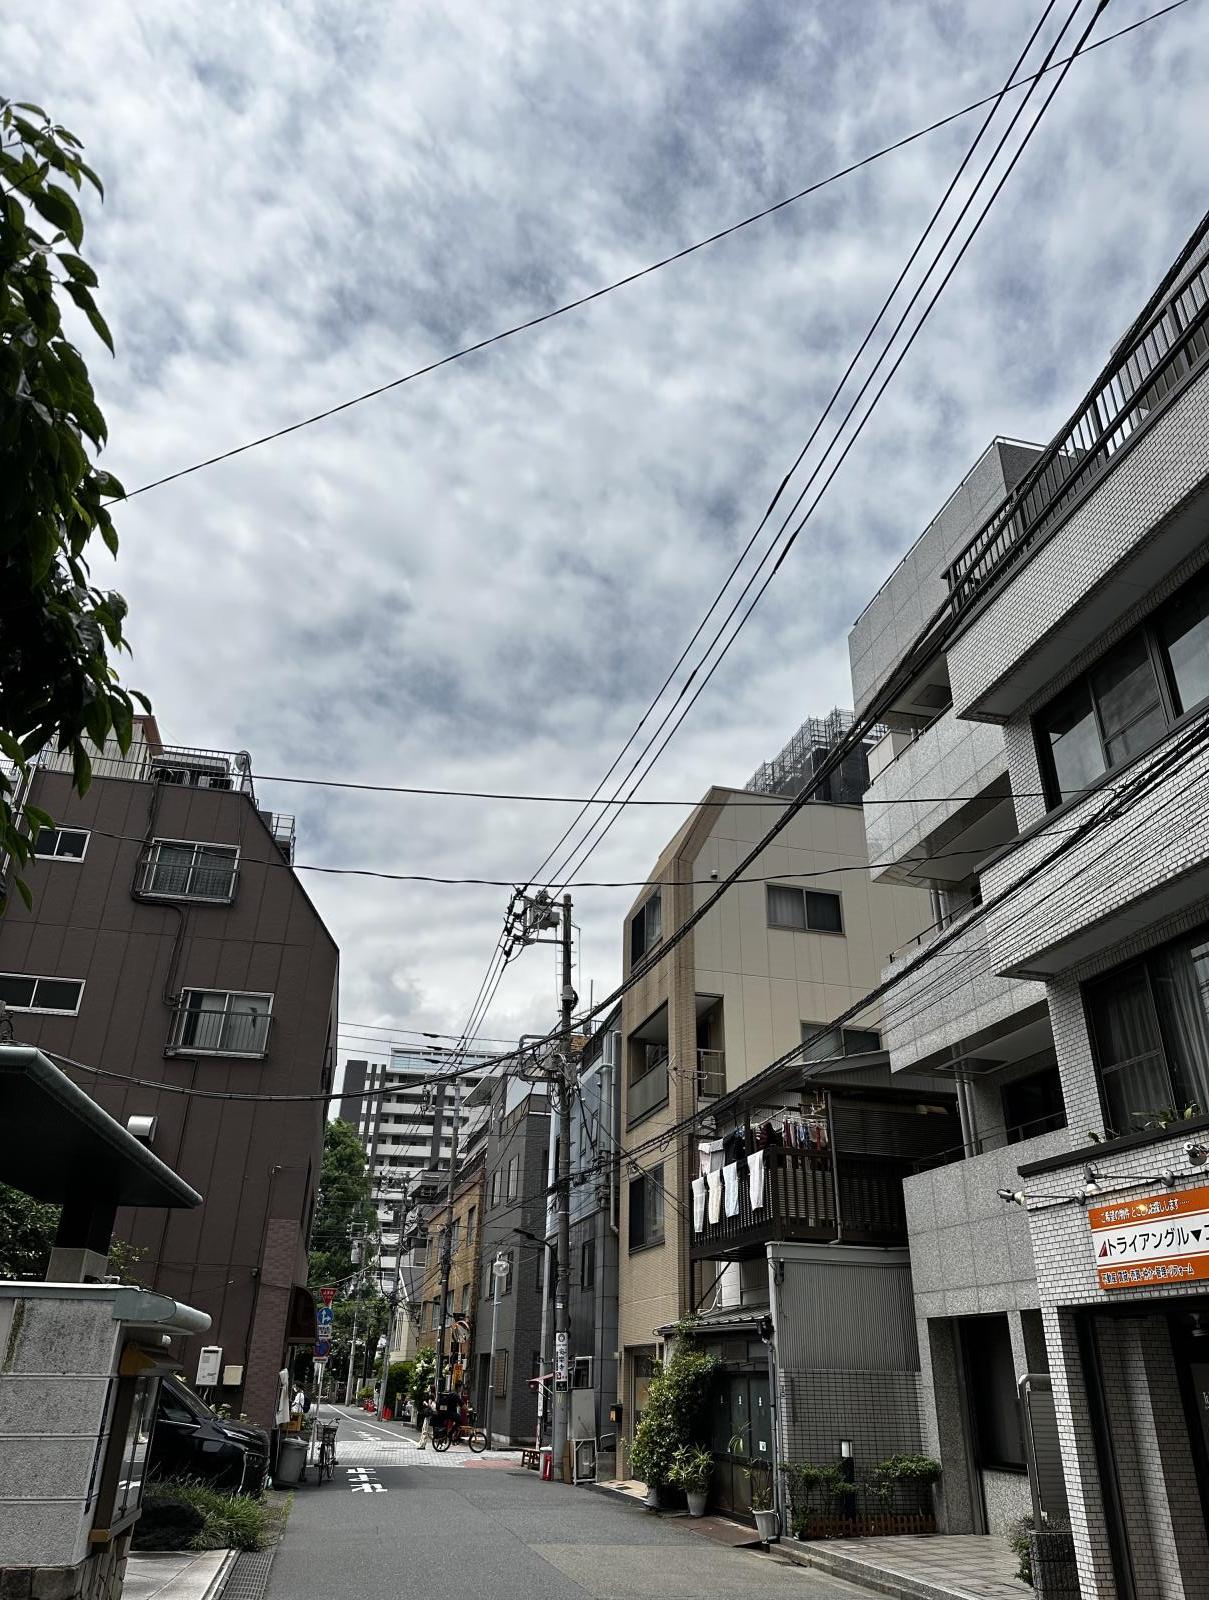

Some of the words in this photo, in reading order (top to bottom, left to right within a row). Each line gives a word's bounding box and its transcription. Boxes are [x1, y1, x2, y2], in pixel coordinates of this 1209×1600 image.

[1107, 1227, 1190, 1256] トライアングル
[346, 1467, 388, 1493] 止まれ
